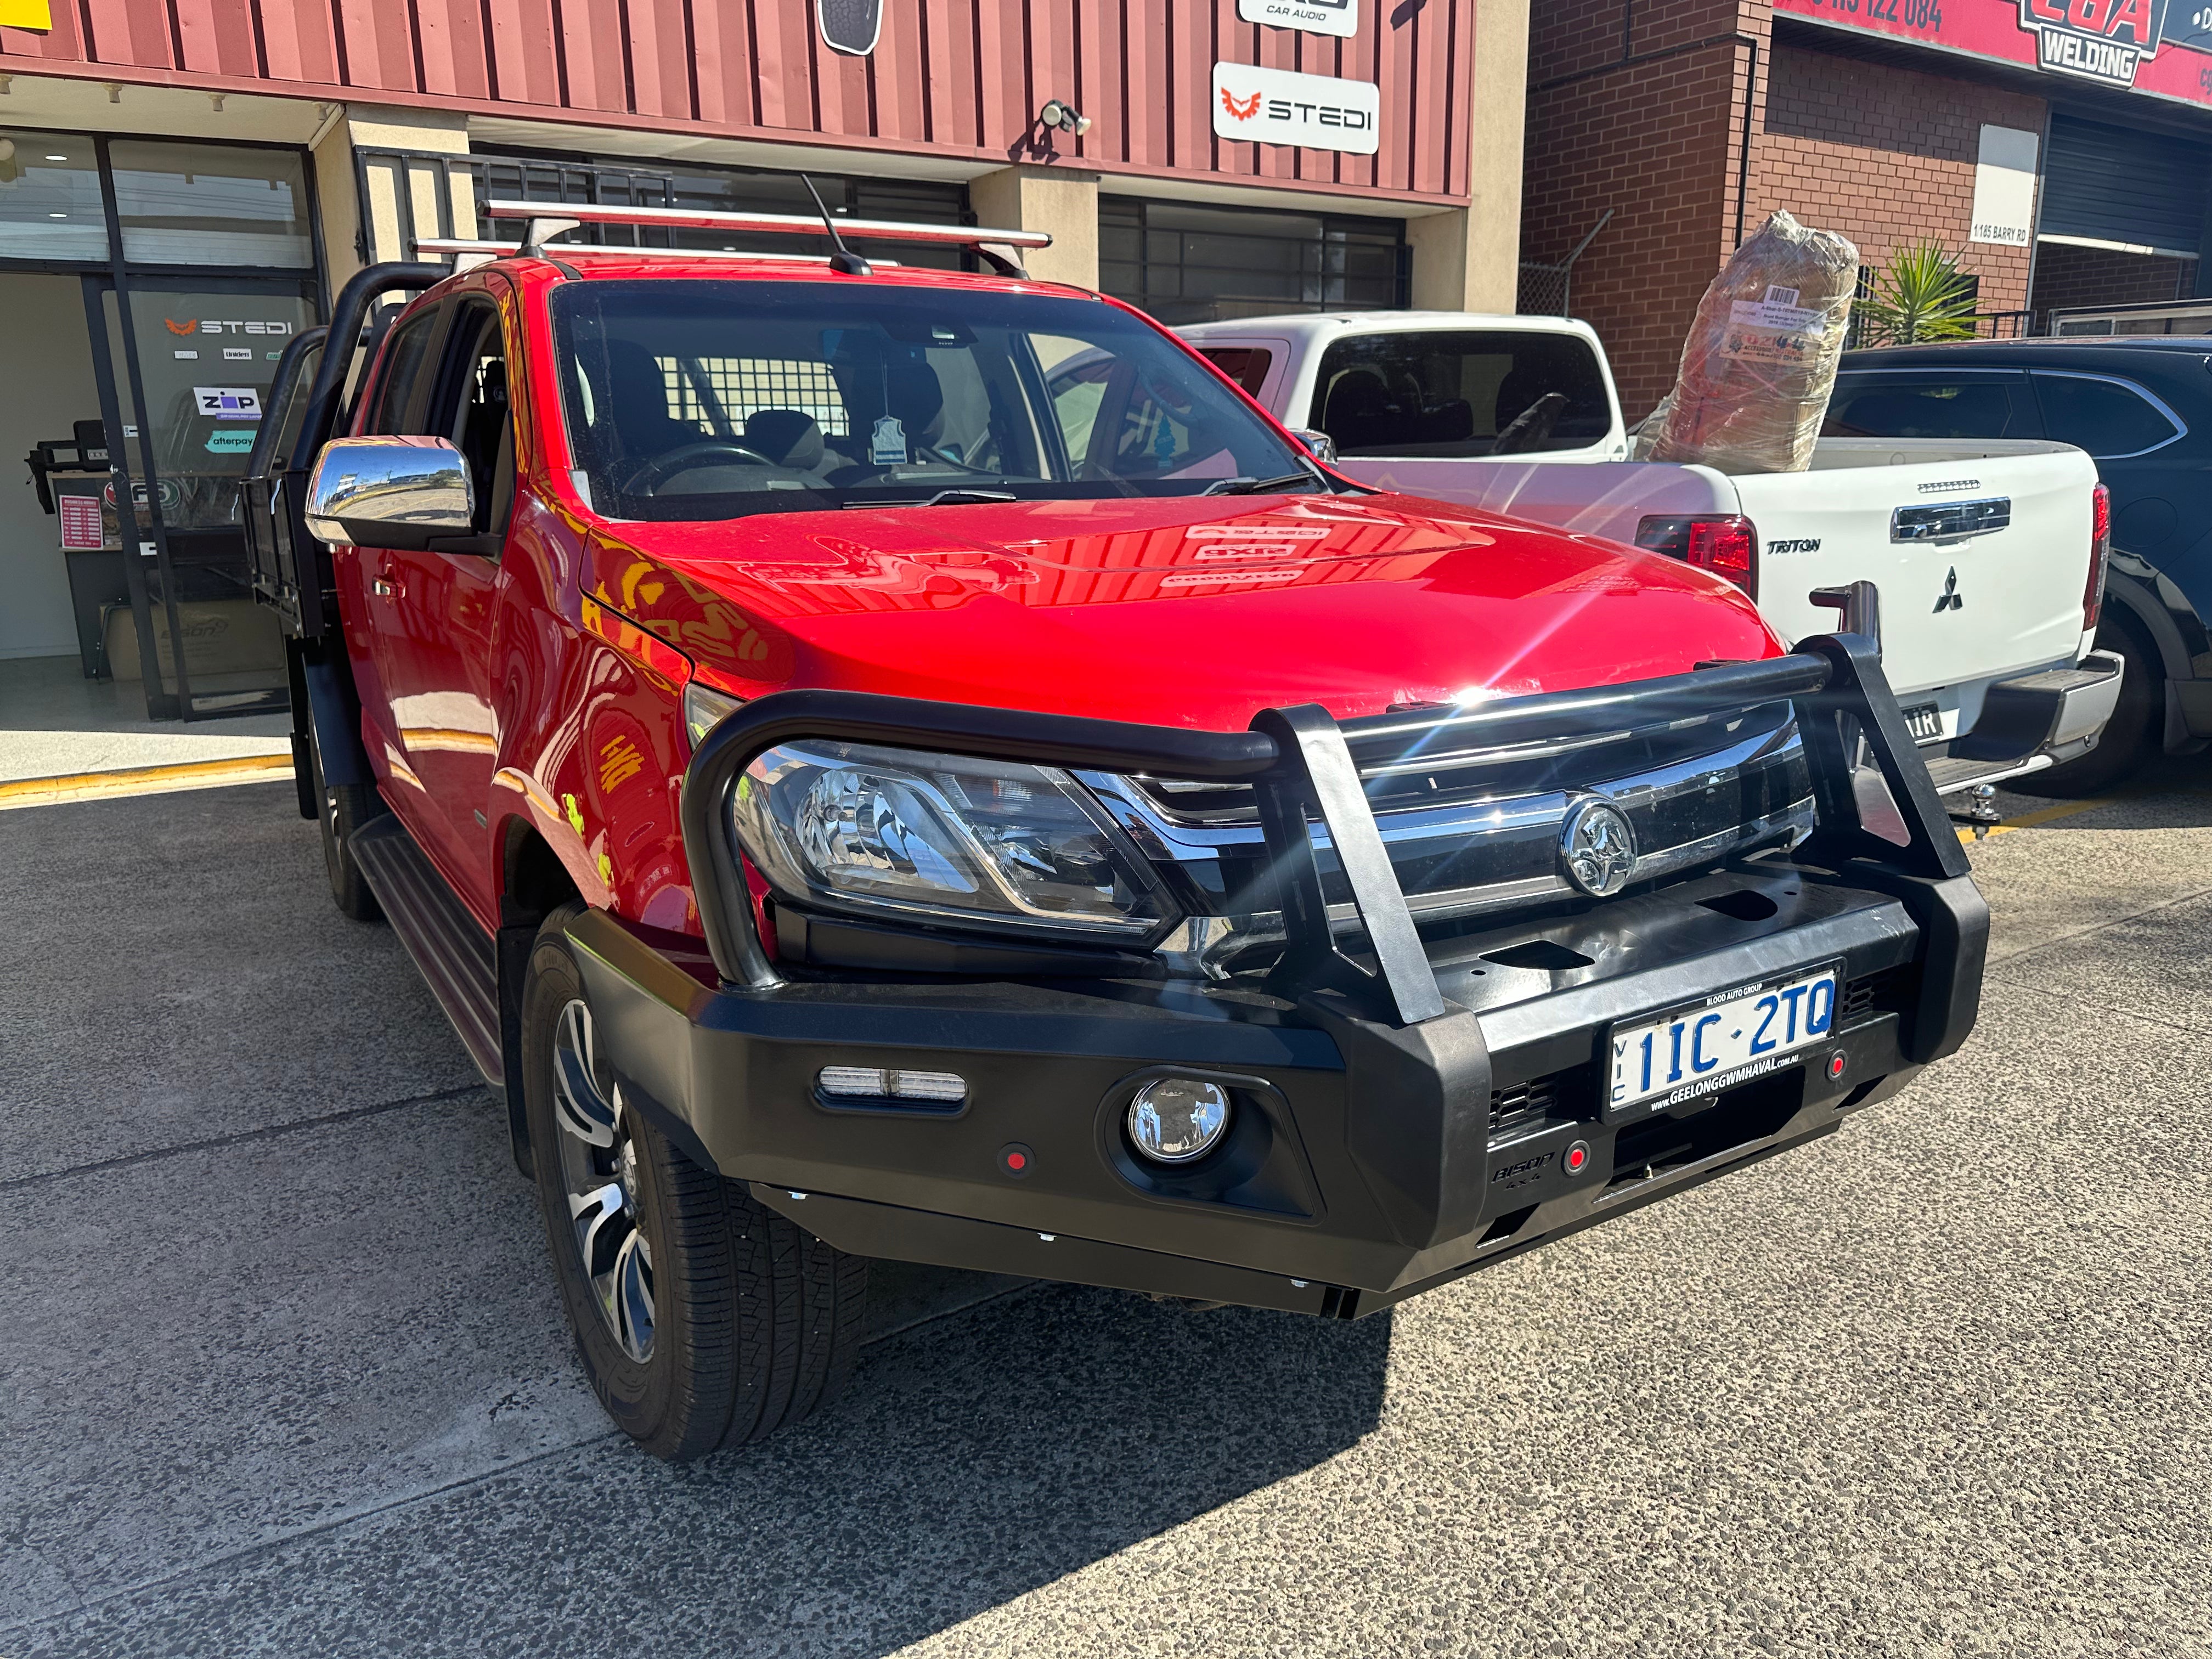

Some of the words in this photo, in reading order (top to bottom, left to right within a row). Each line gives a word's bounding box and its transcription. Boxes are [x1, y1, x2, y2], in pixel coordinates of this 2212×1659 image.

[1267, 5, 1290, 15] CAR
[1293, 10, 1327, 21] AUDIO
[2045, 31, 2136, 79] WELDING
[1268, 99, 1371, 131] STEDI
[1993, 225, 2016, 240] BARRY
[2017, 229, 2026, 242] RD
[201, 320, 292, 335] STEDI
[213, 438, 253, 446] afterpay
[1767, 539, 1821, 555] TRITON
[1706, 994, 1726, 1006] BLOOD
[1726, 989, 1742, 1000] AUTO
[1743, 983, 1762, 995] GROUP
